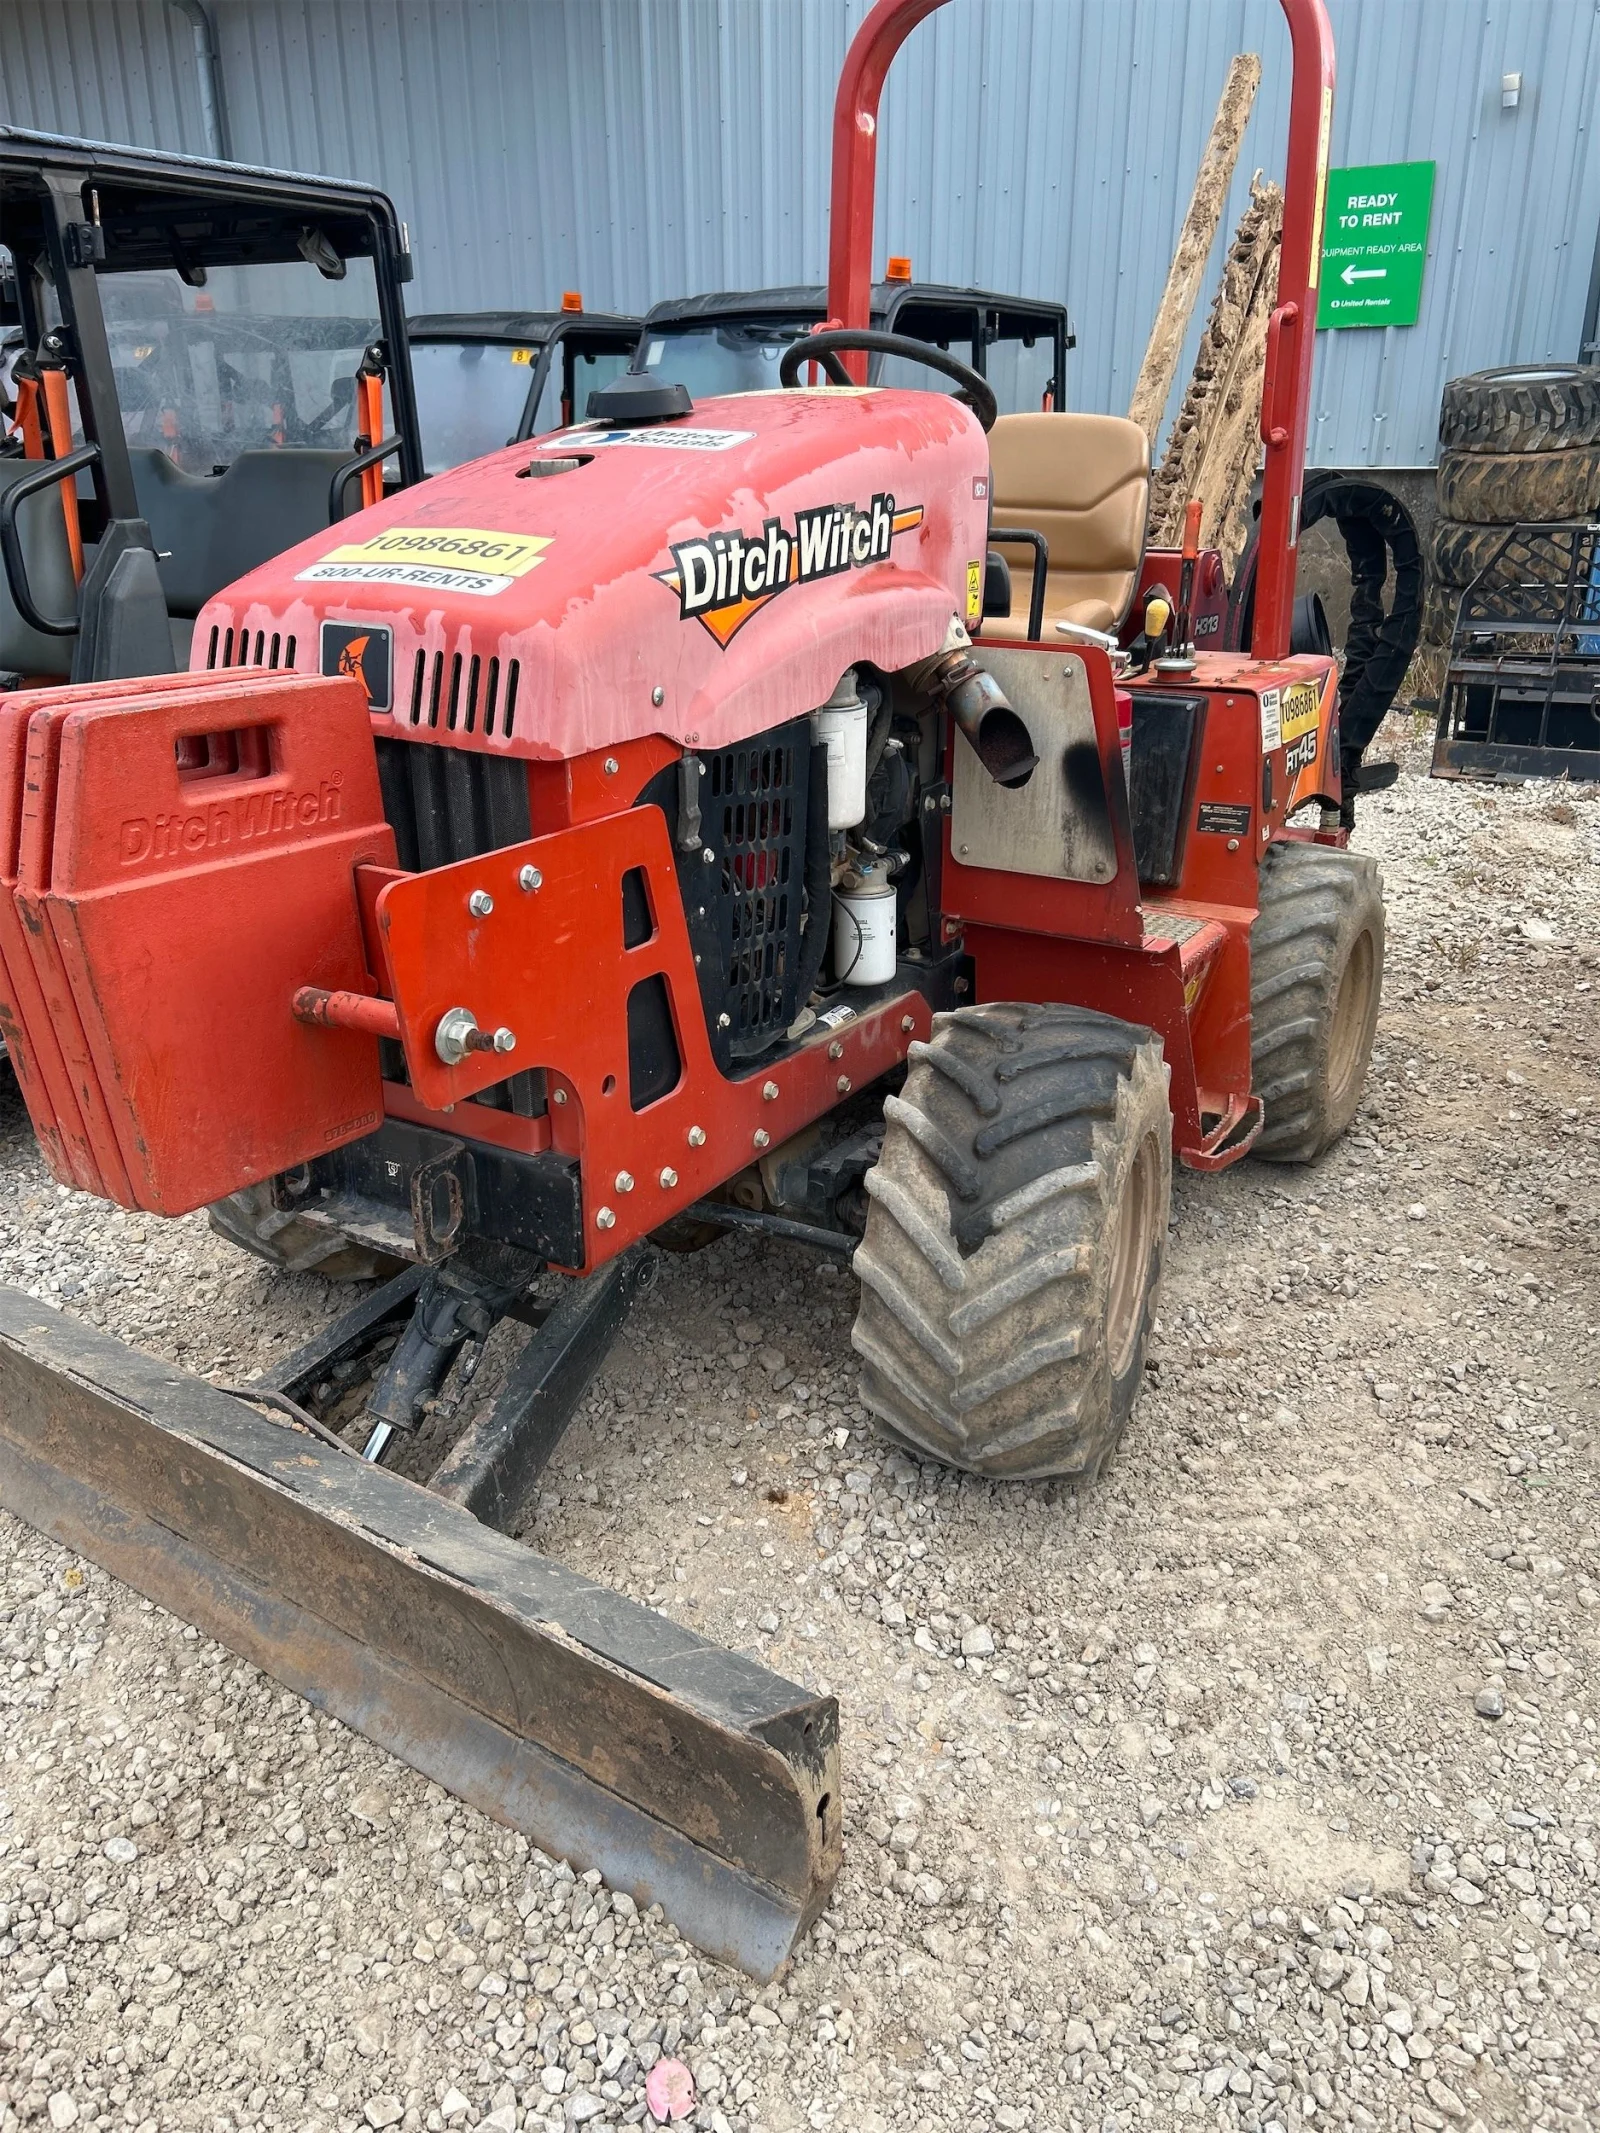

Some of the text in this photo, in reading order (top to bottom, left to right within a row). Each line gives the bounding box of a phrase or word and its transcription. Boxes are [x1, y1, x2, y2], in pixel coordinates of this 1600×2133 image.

[1347, 193, 1398, 209] READY
[1339, 212, 1402, 228] TO RENT
[1322, 242, 1422, 258] QUIPMENT READY AREA
[1341, 299, 1364, 308] United
[621, 437, 725, 448] Rentals
[636, 430, 734, 441] United
[363, 535, 529, 561] 10986861
[677, 525, 789, 611] Ditch
[1194, 614, 1219, 636] H313
[1285, 731, 1317, 776] RT45
